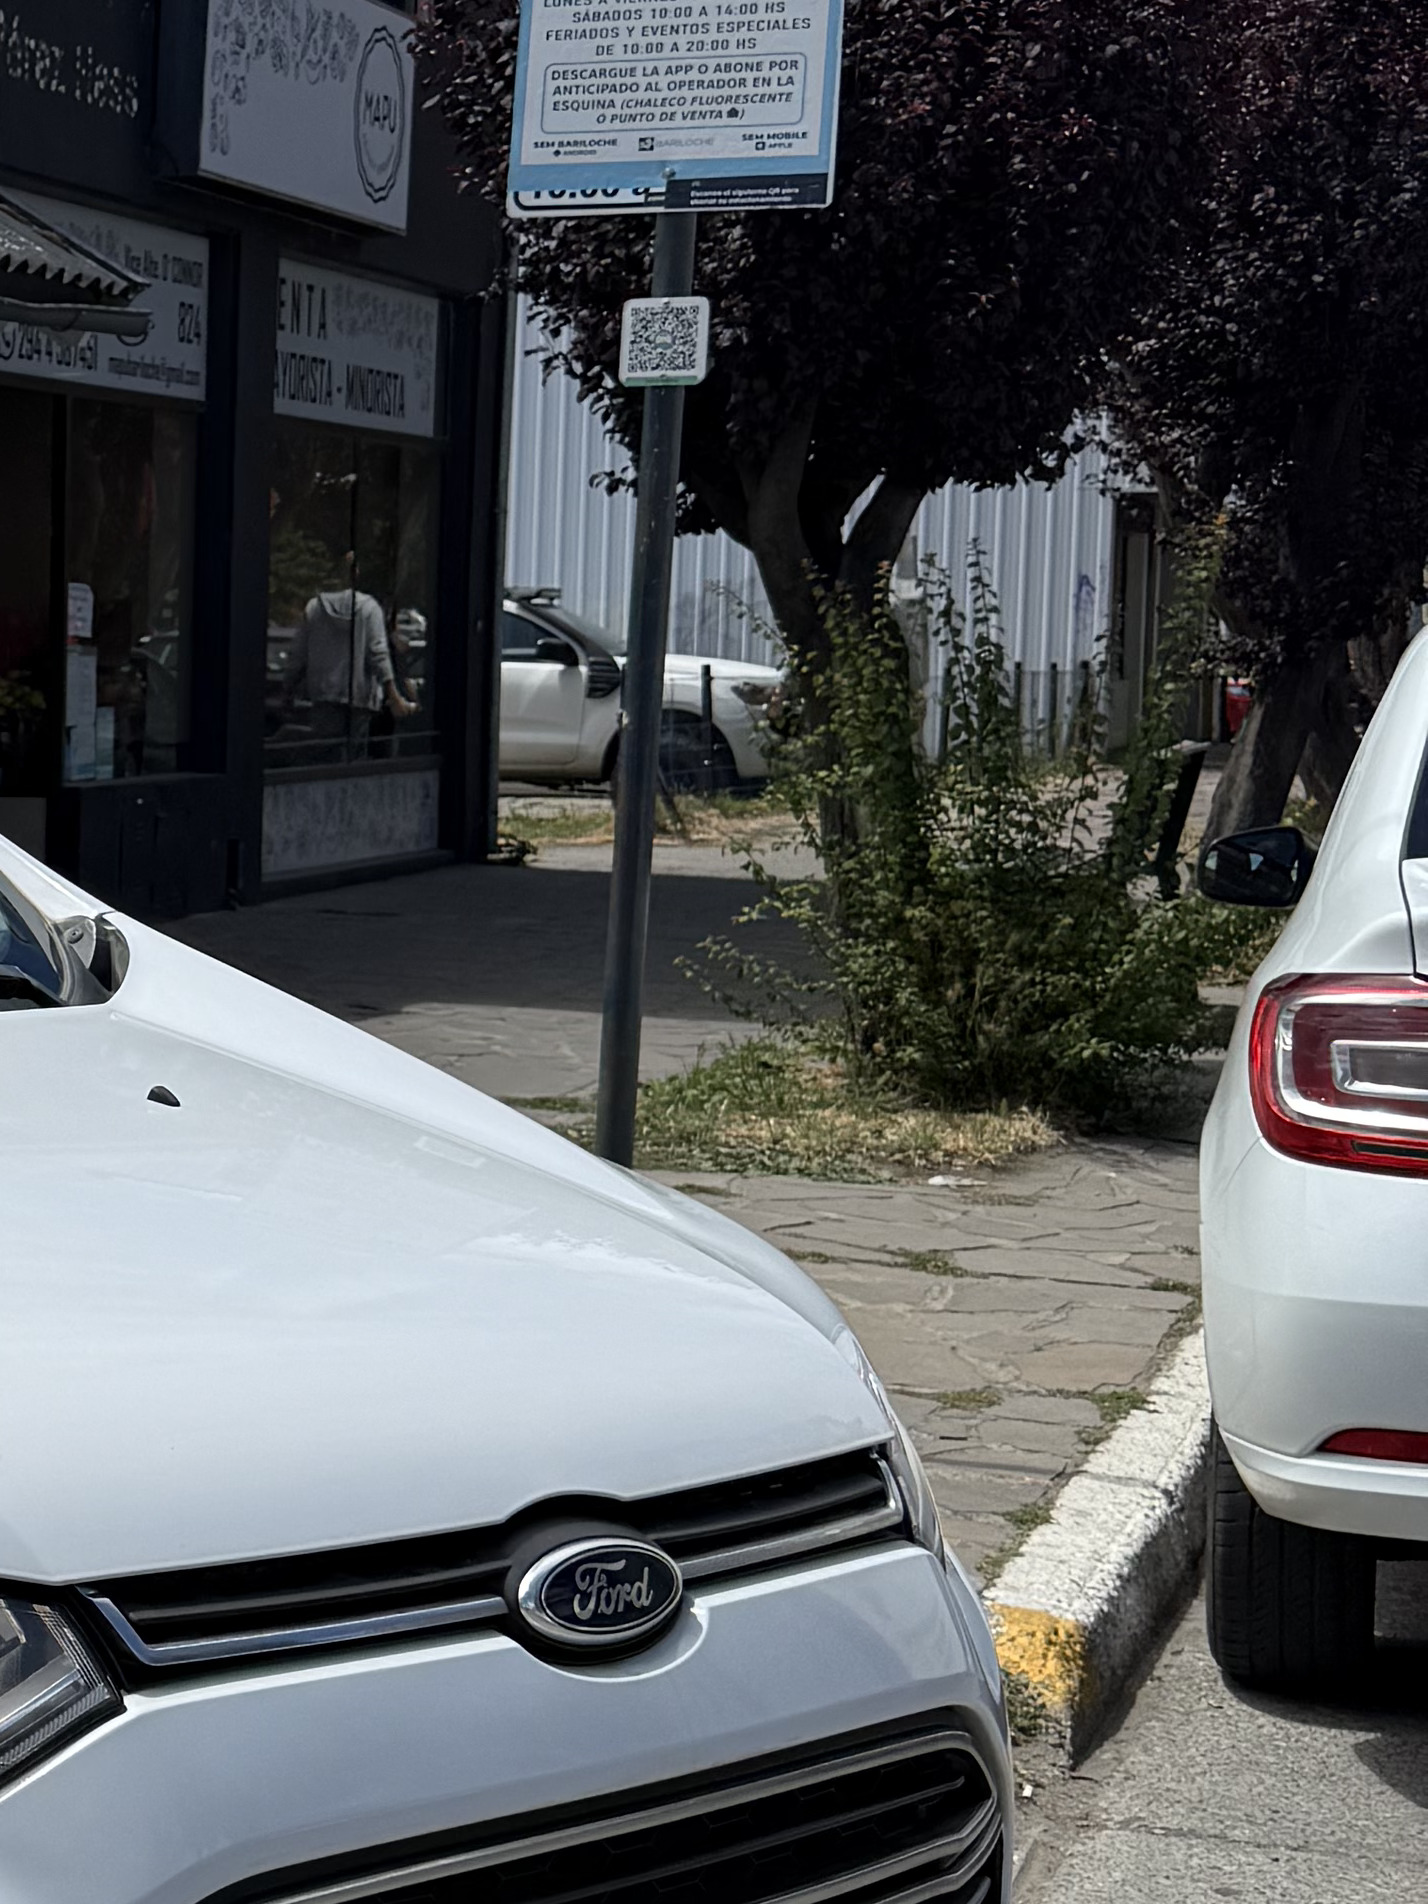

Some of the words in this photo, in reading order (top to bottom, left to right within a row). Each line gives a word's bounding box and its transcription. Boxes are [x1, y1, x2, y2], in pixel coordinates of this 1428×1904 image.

[572, 8, 643, 23] SÁBADOS
[650, 6, 692, 20] 10:00
[698, 5, 708, 16] A
[716, 3, 759, 16] 14:00
[765, 2, 786, 14] HS
[545, 27, 619, 41] FERIADOS
[626, 26, 635, 37] Y
[642, 22, 710, 37] EVENTOS
[717, 18, 811, 34] ESPECIALES
[595, 44, 614, 56] DE
[622, 41, 664, 55] 10:00
[670, 41, 680, 52] A
[686, 39, 730, 52] 20:00
[736, 38, 757, 50] HS
[551, 66, 637, 81] DESCARGUE
[642, 65, 660, 77] LA
[664, 64, 694, 76] APP
[698, 63, 708, 75] O
[713, 61, 763, 74] ABONE
[769, 59, 799, 71] POR
[552, 81, 639, 96] ANTICIPADO
[644, 81, 663, 92] AL
[667, 77, 747, 91] OPERADOR
[752, 77, 772, 88] EN
[777, 75, 795, 87] LA
[552, 98, 616, 112] ESQUINA
[620, 95, 686, 111] (CHALECO
[690, 91, 793, 107] FLUORESCENTE
[363, 92, 397, 137] MAPU
[610, 109, 655, 124] PUNTO
[659, 108, 677, 122] DE
[680, 107, 723, 121] VENTA
[278, 277, 328, 341] ENTA
[177, 300, 202, 346] 824
[345, 362, 406, 420] MINORISTA
[573, 1558, 654, 1621] Ford
